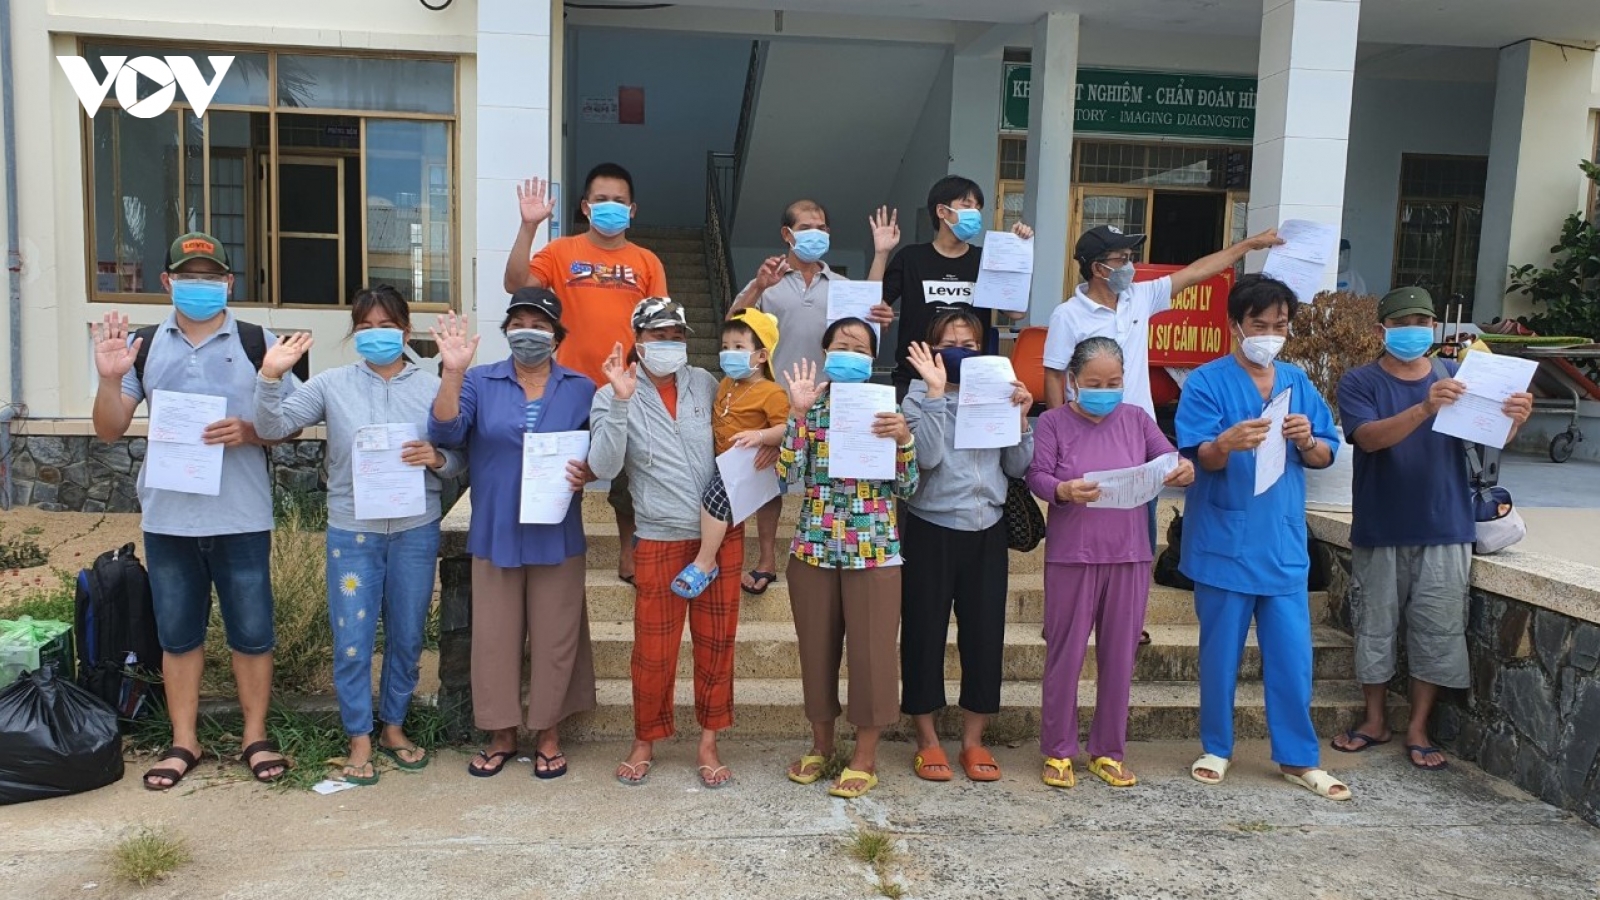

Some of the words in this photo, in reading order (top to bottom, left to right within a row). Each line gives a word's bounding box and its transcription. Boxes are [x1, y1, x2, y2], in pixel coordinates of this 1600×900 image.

[1087, 81, 1144, 107] NGHIỆM
[1156, 78, 1194, 106] CHẨN
[1197, 85, 1235, 108] ĐOÁN
[1075, 108, 1108, 121] TORY
[1119, 110, 1173, 125] IMAGING
[1177, 113, 1250, 129] DIAGNOSTIC
[1200, 285, 1212, 311] LY
[1156, 322, 1173, 357] SỰ
[1173, 316, 1198, 351] CẤM
[1201, 322, 1221, 353] VÀO
